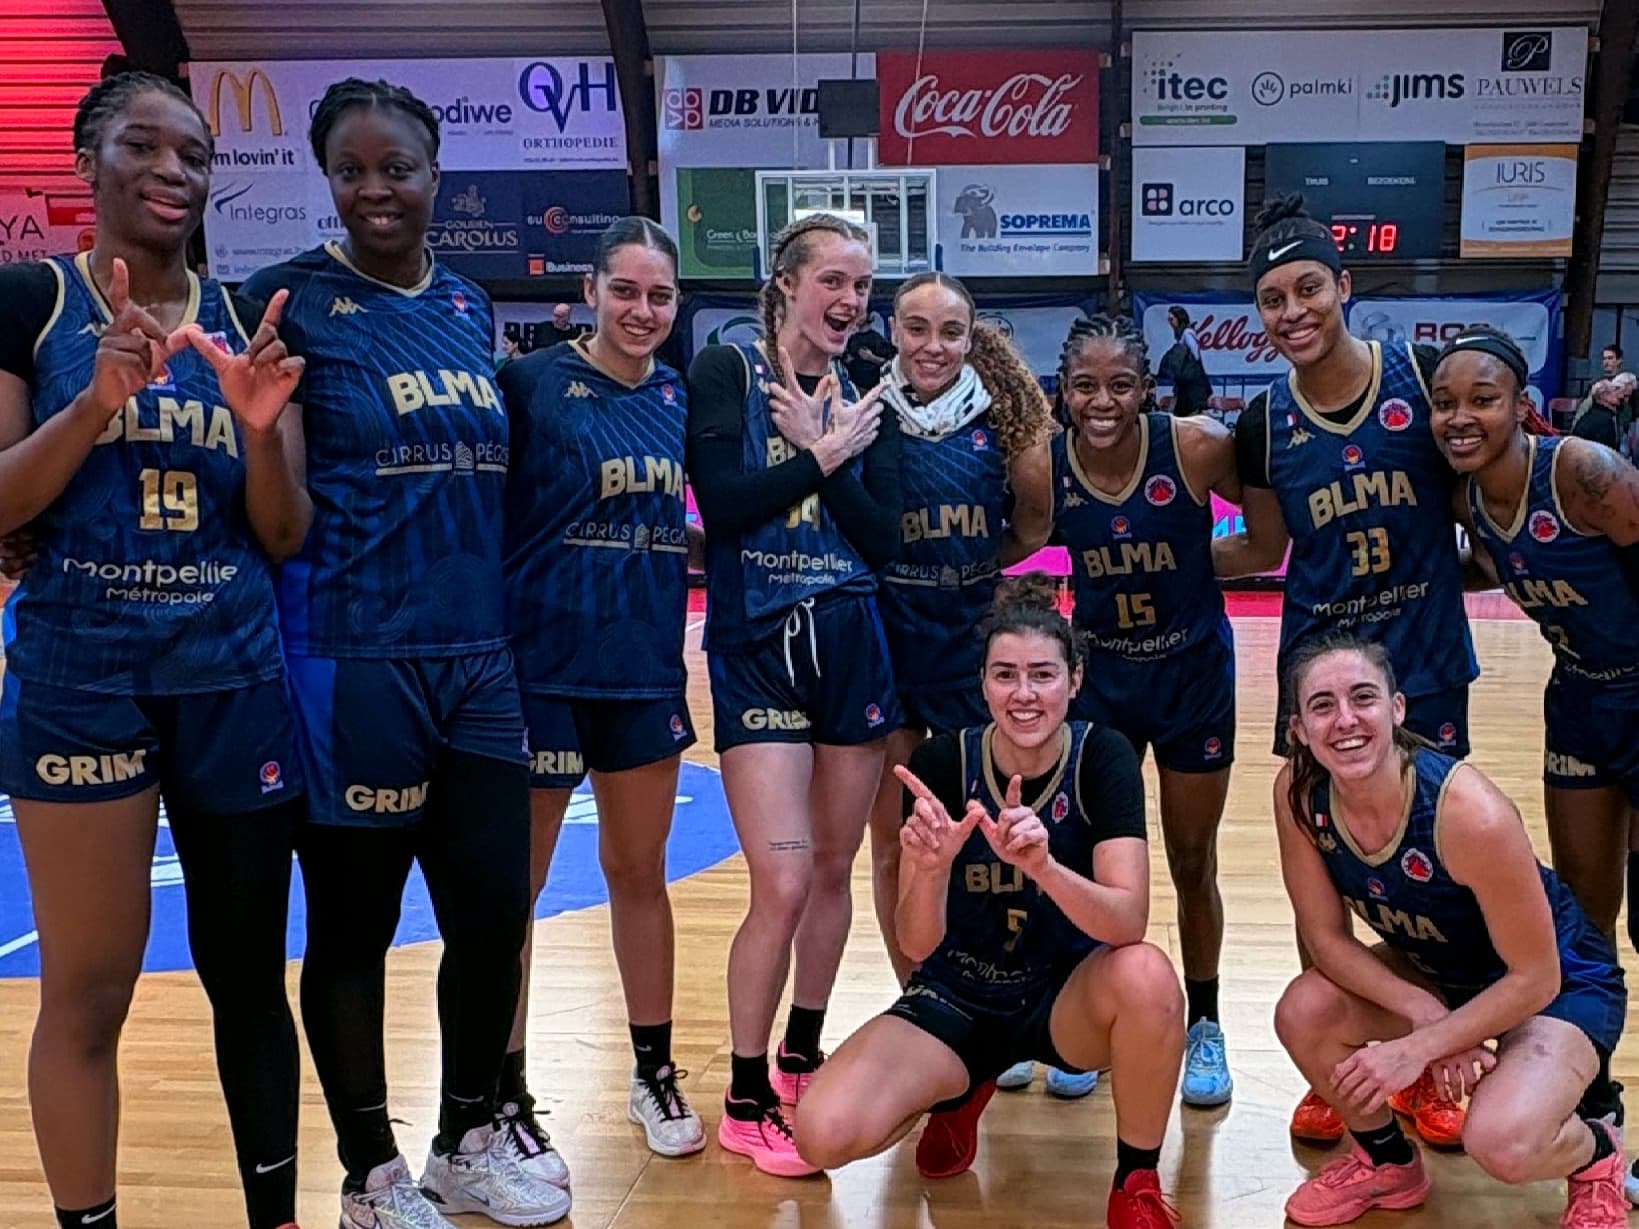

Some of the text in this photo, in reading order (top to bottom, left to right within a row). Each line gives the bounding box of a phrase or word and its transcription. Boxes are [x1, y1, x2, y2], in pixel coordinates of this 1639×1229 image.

[1157, 69, 1228, 100] itec
[1290, 78, 1352, 98] palmki
[1477, 77, 1582, 97] PAUWELS
[709, 89, 760, 115] DB
[894, 73, 1085, 137] Coca-Cola
[709, 119, 742, 128] MEDIA
[523, 137, 618, 149] ORTHOPEDIE
[233, 148, 279, 166] lovin'
[281, 148, 295, 166] it
[1496, 161, 1545, 184] IURIS
[1179, 199, 1235, 216] arco
[1000, 213, 1091, 229] SOPREMA
[424, 230, 519, 250] CAROLUS
[1415, 322, 1490, 342] RO
[387, 369, 505, 417] BLMA
[375, 443, 453, 467] CIRRUS
[600, 455, 685, 502] BLMA
[139, 468, 199, 532] 19
[1308, 470, 1418, 530] BLMA
[565, 522, 631, 541] CIRRUS
[902, 504, 989, 543] BLMA
[1082, 542, 1176, 578] BLMA
[1346, 527, 1391, 576] 33
[1503, 579, 1589, 608] LMA
[1115, 592, 1157, 629] 15
[36, 750, 146, 785] GRIM
[1544, 751, 1597, 777] RIM
